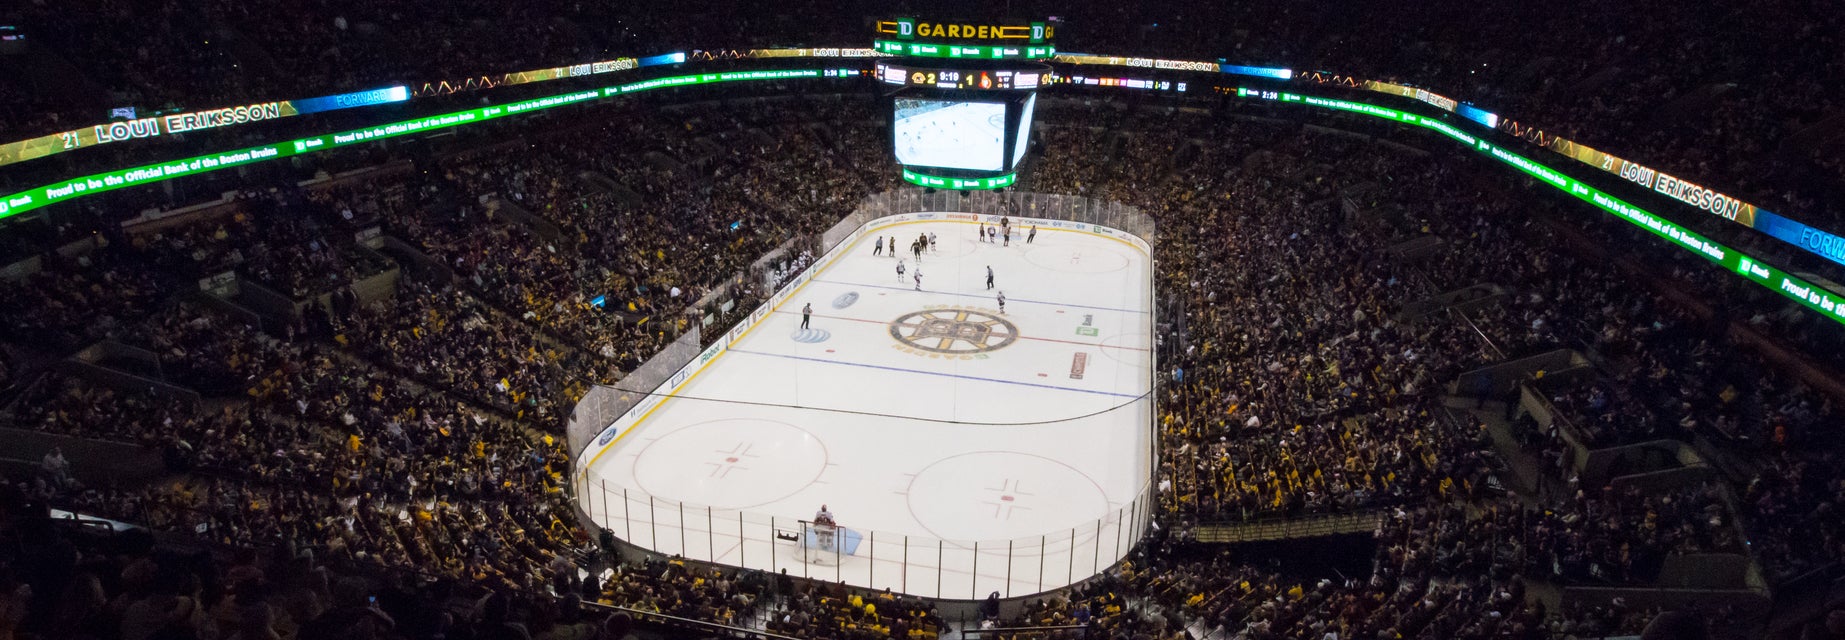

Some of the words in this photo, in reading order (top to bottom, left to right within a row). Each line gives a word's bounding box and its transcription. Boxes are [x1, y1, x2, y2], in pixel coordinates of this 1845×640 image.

[898, 22, 912, 35] TD
[917, 23, 1003, 38] GARDEN
[1033, 26, 1043, 39] TD
[813, 48, 839, 57] LOUI
[556, 68, 563, 78] 21
[569, 64, 591, 77] LOUI
[592, 59, 633, 74] ERIKSSON
[1126, 57, 1153, 67] LOUI
[1155, 59, 1213, 72] ERIKSSON
[927, 73, 935, 84] 2
[966, 75, 973, 85] 1
[62, 131, 80, 149] 21
[95, 117, 160, 144] LOUI
[166, 102, 280, 134] ERIKSSON
[336, 91, 387, 107] FORWARD
[334, 133, 355, 144] Proud
[356, 132, 364, 140] to
[364, 130, 373, 138] be
[374, 128, 385, 137] the
[386, 123, 407, 135] Official
[408, 121, 422, 131] Bank
[423, 119, 430, 128] of
[430, 118, 440, 127] the
[10, 195, 32, 208] Bank
[46, 183, 74, 199] Proud
[74, 182, 86, 192] to
[88, 178, 103, 189] be
[104, 175, 124, 186] the
[125, 167, 163, 182] Official
[164, 162, 189, 175] Bank
[190, 159, 200, 169] of
[202, 156, 219, 168] the
[219, 152, 250, 165] Boston
[251, 147, 277, 159] Bruins
[1602, 154, 1614, 171] 21
[1620, 160, 1654, 188] LOUI
[1654, 172, 1741, 221] ERIKSSON
[1800, 227, 1845, 260] FORW
[1629, 209, 1648, 224] Official
[1662, 224, 1670, 234] of
[1669, 227, 1680, 240] the
[1782, 278, 1810, 299] Proud
[1809, 292, 1820, 304] to
[1821, 295, 1834, 311] be
[1835, 303, 1845, 317] th
